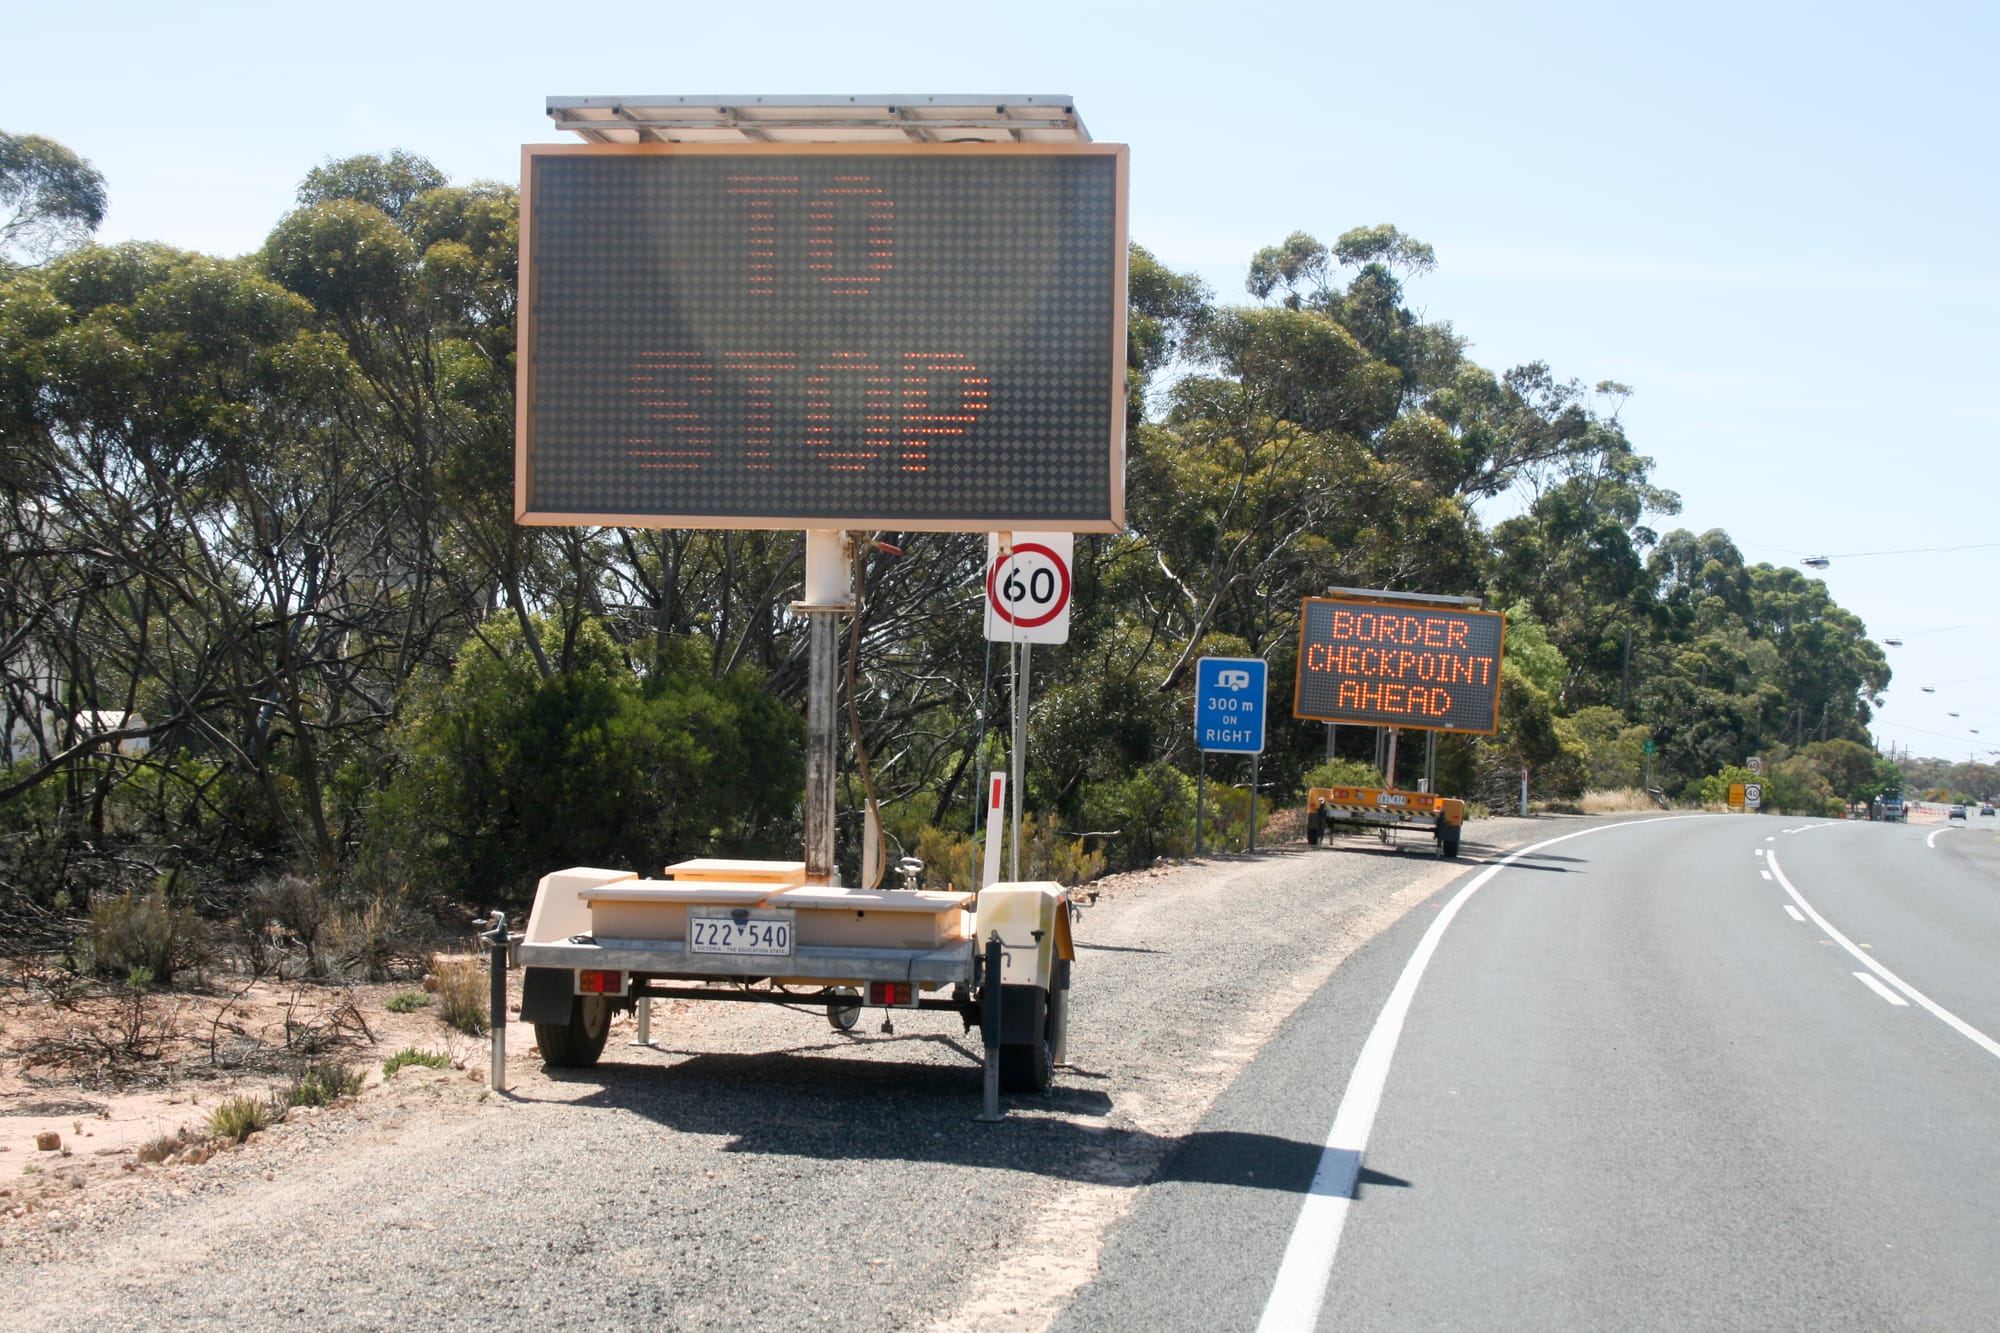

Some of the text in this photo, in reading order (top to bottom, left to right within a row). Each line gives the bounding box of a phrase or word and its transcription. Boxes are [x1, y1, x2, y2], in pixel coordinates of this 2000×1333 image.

[727, 175, 894, 295] TO
[628, 351, 989, 472] STOP
[1003, 567, 1055, 604] 60
[1332, 610, 1470, 650] BORDER
[1307, 643, 1493, 686] CHECKPOINT
[1208, 697, 1253, 712] 300 m
[1338, 680, 1452, 717] AHEAD
[1206, 728, 1252, 743] RIGHT
[1222, 715, 1238, 725] ON
[695, 923, 787, 948] Z22 540
